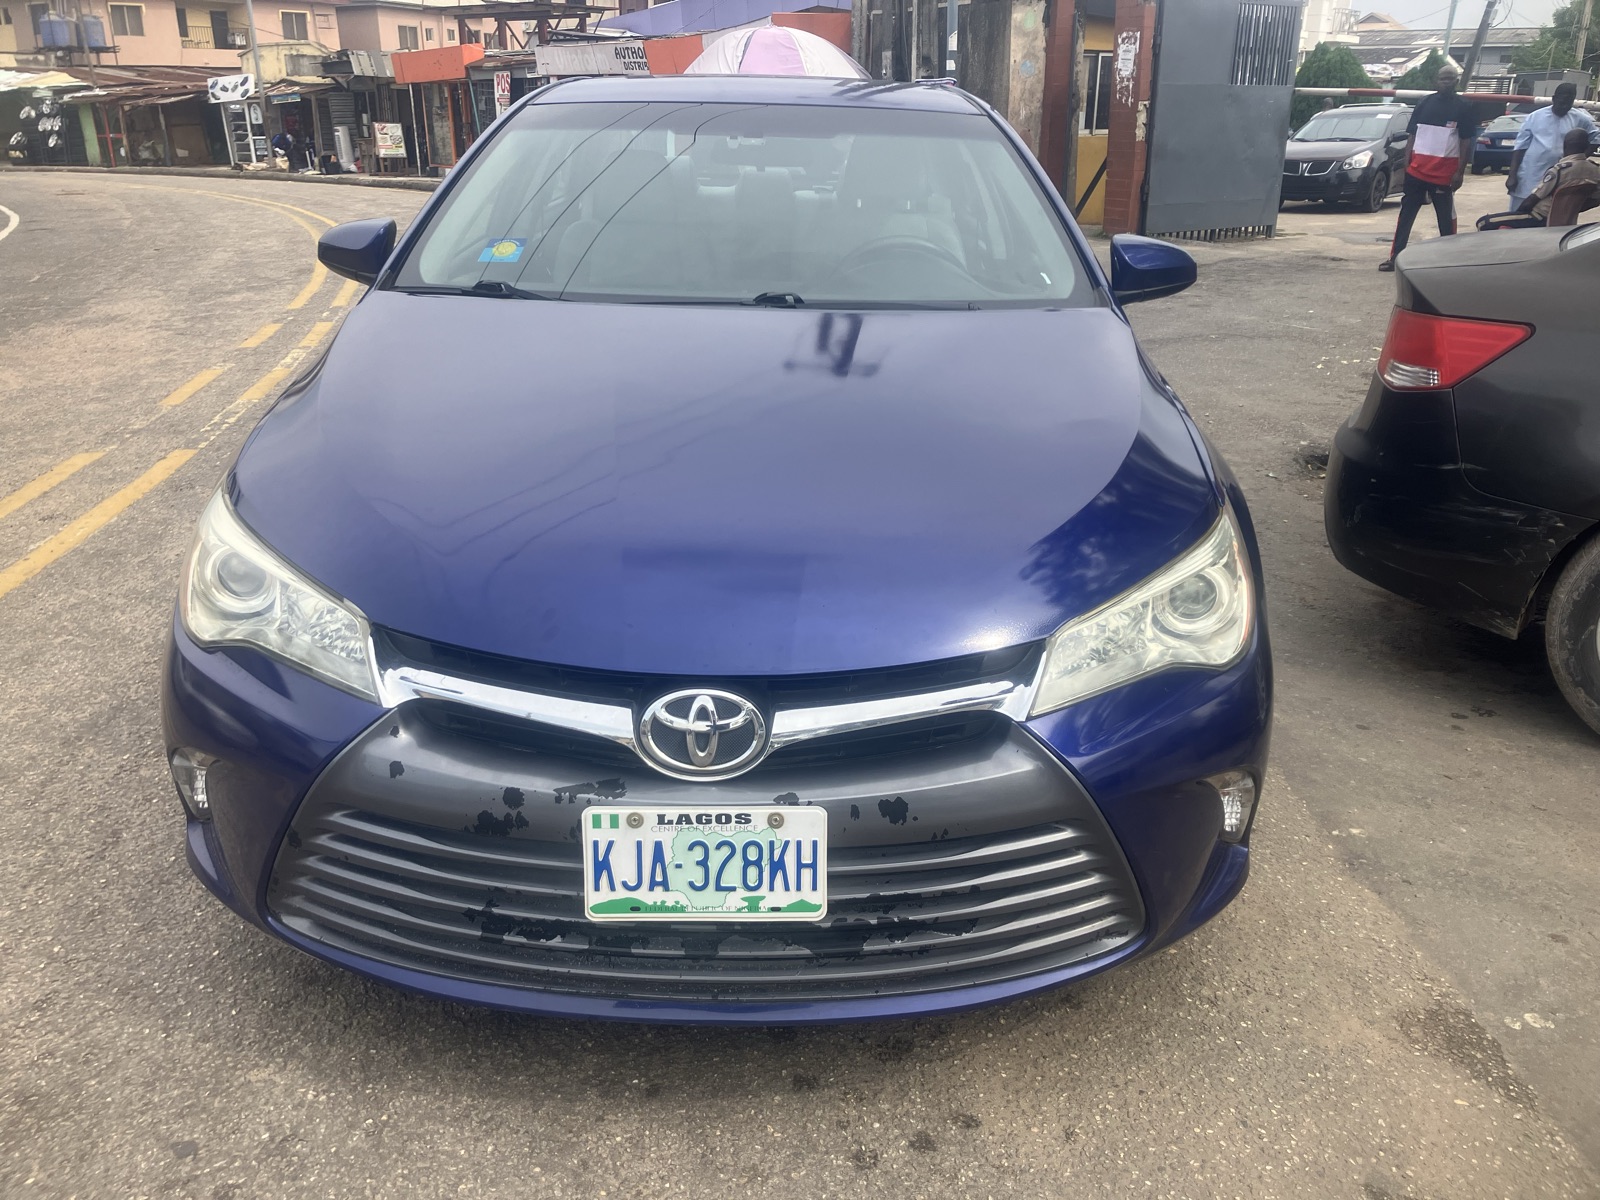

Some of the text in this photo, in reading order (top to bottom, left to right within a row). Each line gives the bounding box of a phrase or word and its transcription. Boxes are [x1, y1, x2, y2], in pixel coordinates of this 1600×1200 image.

[496, 73, 511, 94] POS
[656, 813, 752, 825] LAGOS
[650, 825, 684, 833] CENTRE
[703, 824, 758, 832] EXCELLENCE
